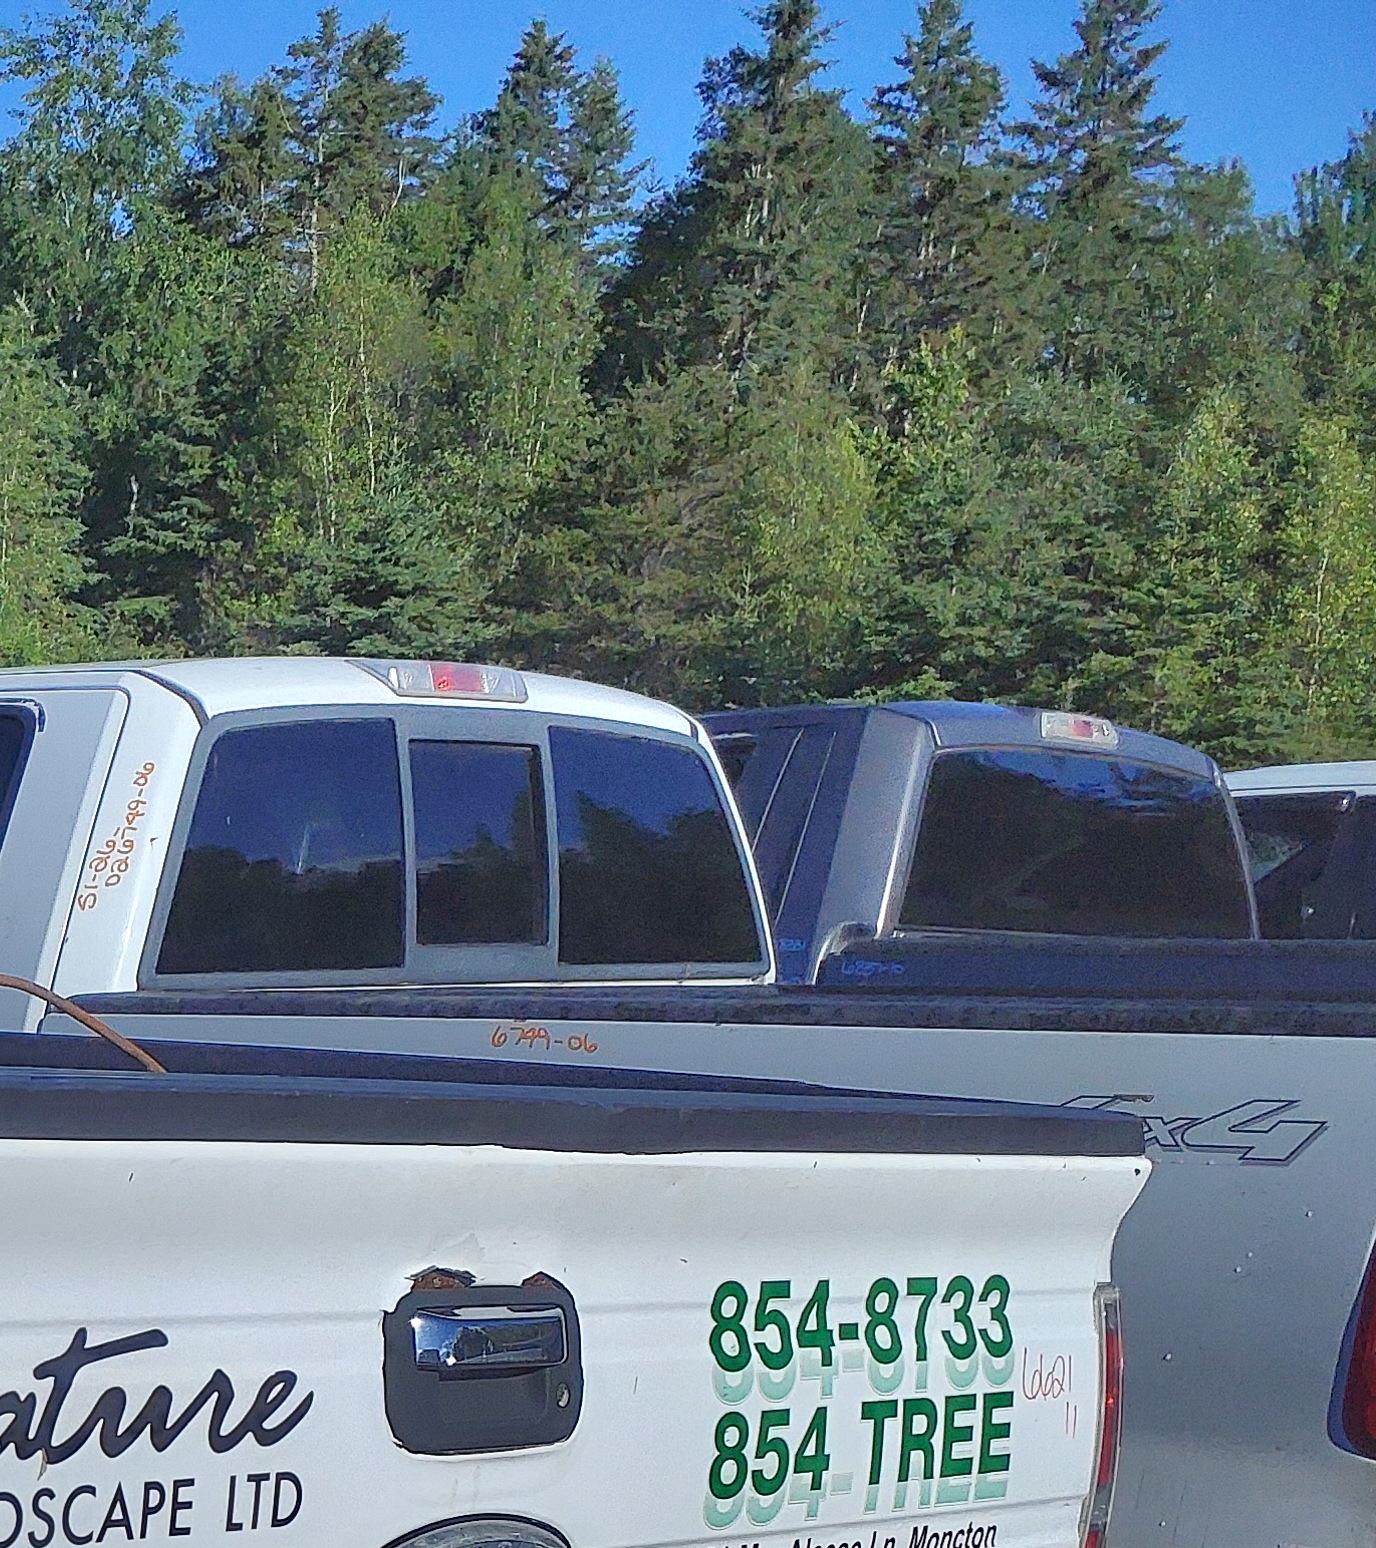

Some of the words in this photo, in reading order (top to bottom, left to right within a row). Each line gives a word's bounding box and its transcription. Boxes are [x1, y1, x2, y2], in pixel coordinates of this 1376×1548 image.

[708, 1274, 1014, 1373] 854-8733
[860, 1391, 1015, 1487] TREE
[224, 1470, 304, 1533] LTD
